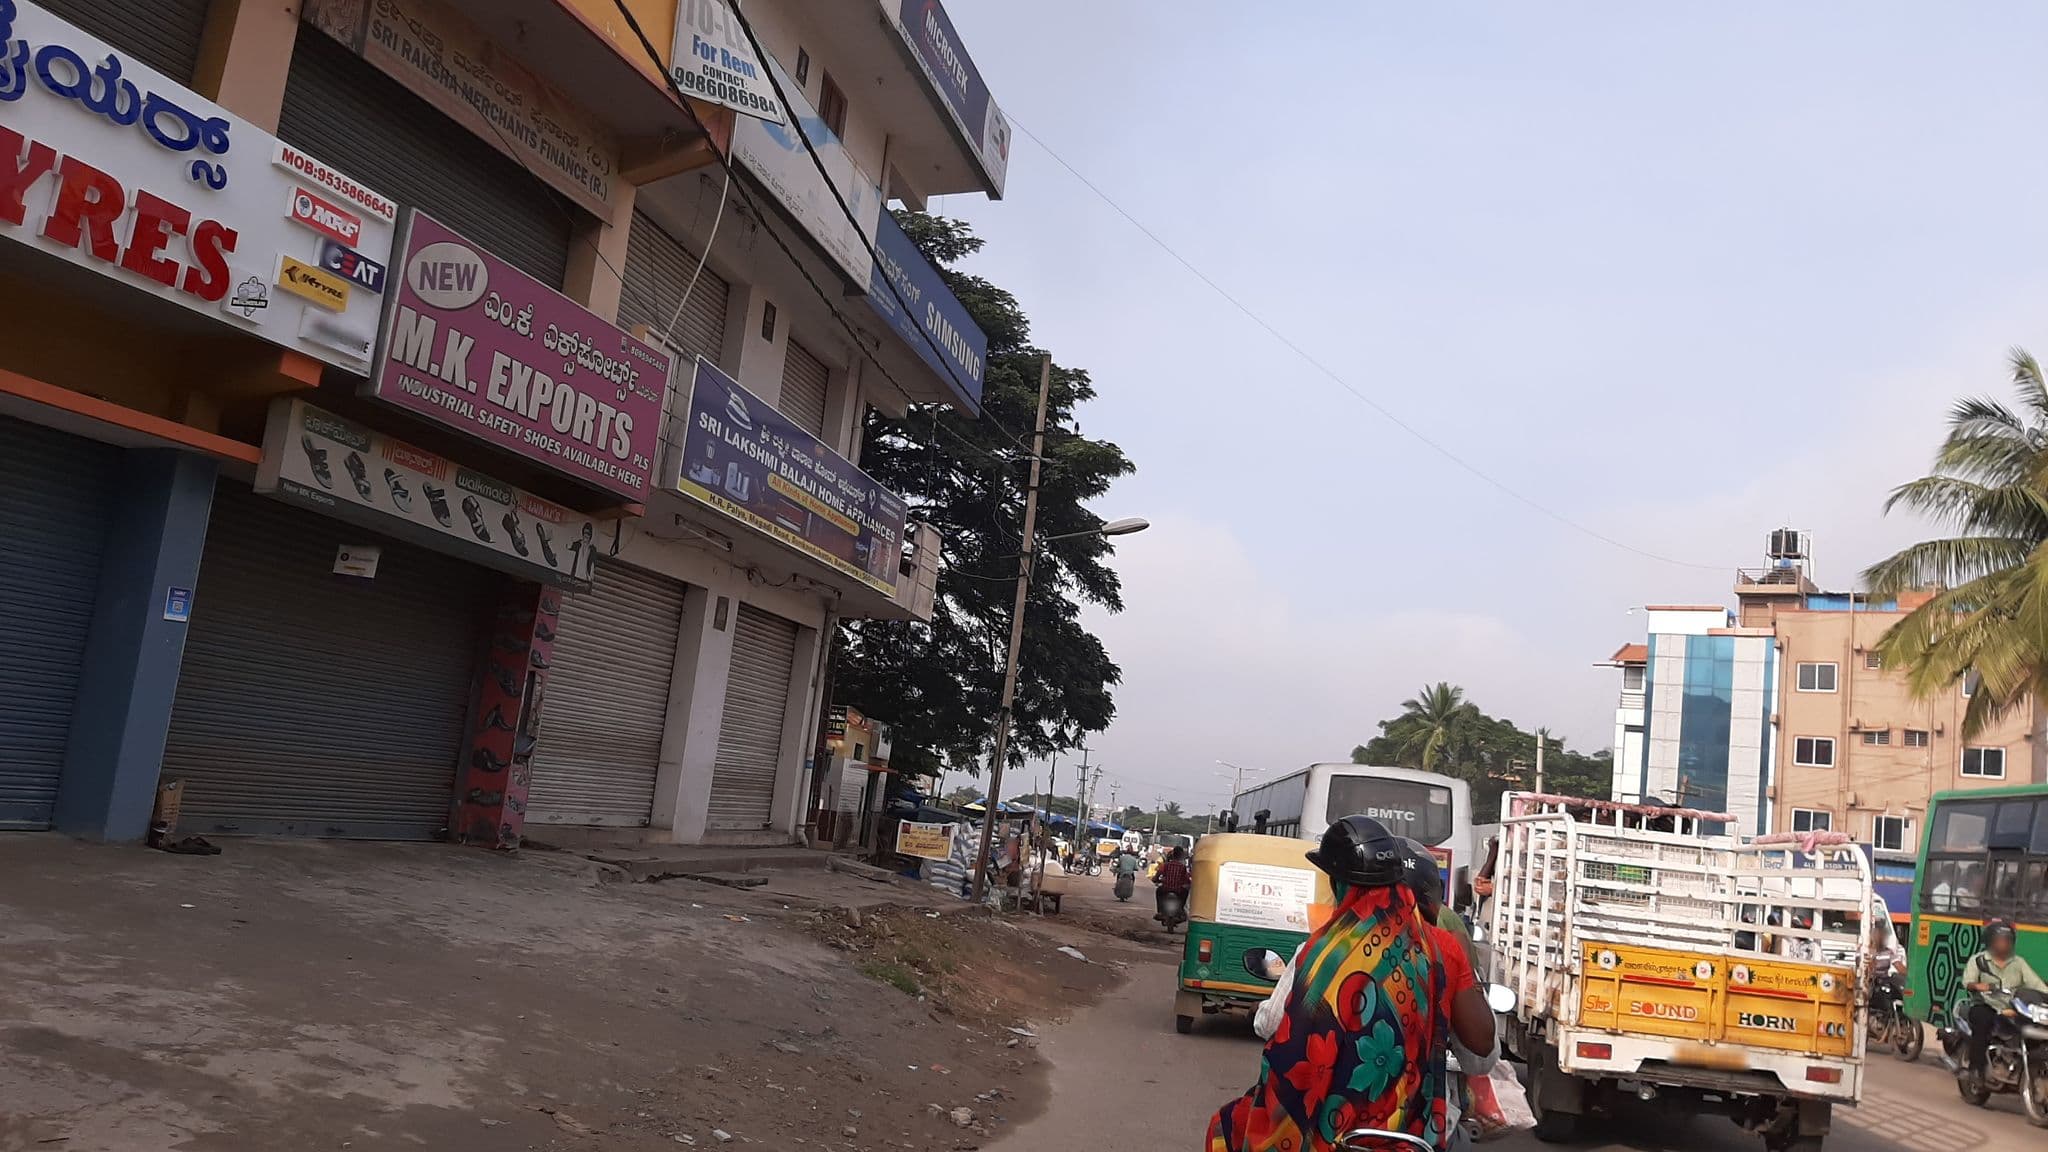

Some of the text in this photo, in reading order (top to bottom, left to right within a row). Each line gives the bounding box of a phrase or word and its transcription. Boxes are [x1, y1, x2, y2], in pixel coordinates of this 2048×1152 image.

[692, 34, 718, 63] For
[925, 9, 968, 95] MICROTEK
[371, 19, 398, 51] SRI
[401, 38, 458, 95] RAKSHA
[460, 82, 538, 150] MERCHANTS
[540, 138, 588, 185] FINANCE
[674, 66, 778, 115] 9986086984
[281, 147, 394, 220] MOB:9535866643
[311, 205, 359, 239] MRF
[419, 261, 478, 292] NEW
[926, 301, 980, 382] SAMSUNG
[391, 305, 634, 460] M.K. EXPORTS
[399, 375, 642, 490] INDUSTRIAL SAFETY SHOES AVAILABLE HERE
[632, 453, 649, 471] PLS
[698, 411, 722, 438] SRI
[724, 426, 778, 472] LAKSHMI
[780, 461, 817, 500] BALAJI
[818, 485, 845, 518] HOME
[845, 503, 897, 545] APPLIANCES
[457, 473, 511, 506] walkmate
[1367, 807, 1416, 822] BMTC
[1630, 1001, 1698, 1021] SOUND
[1738, 1011, 1797, 1032] HORN
